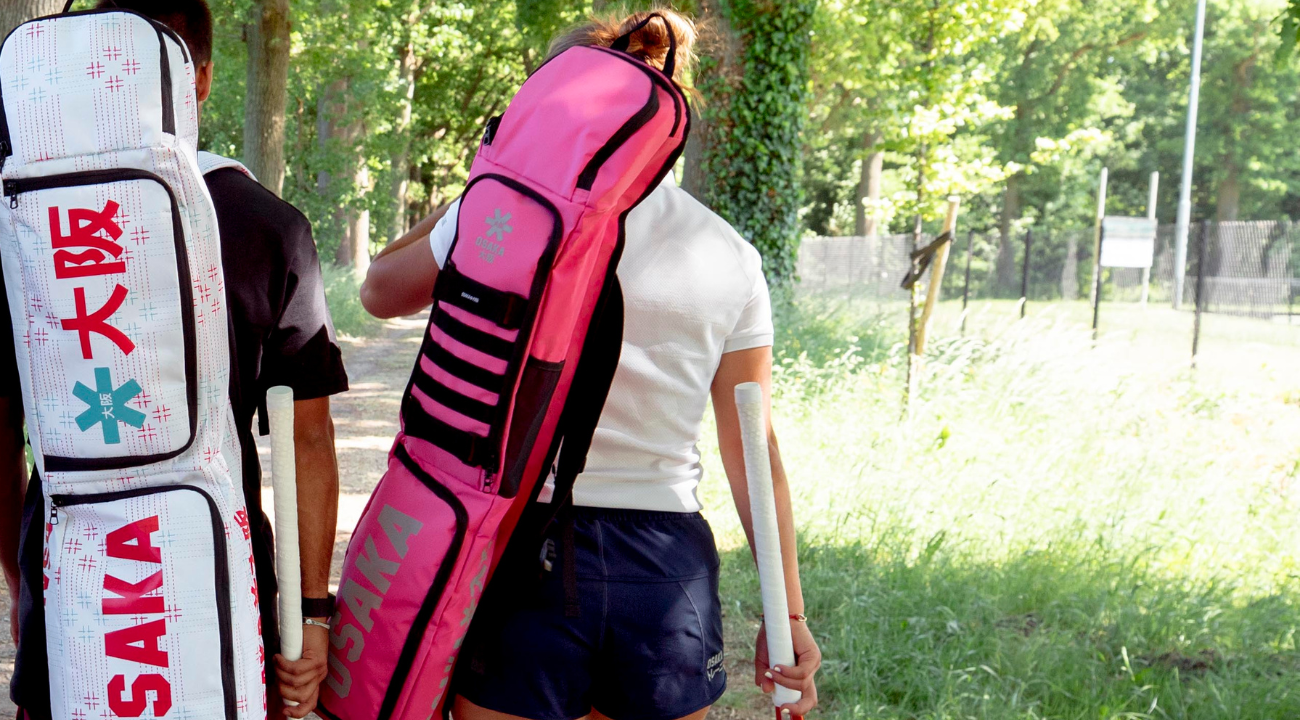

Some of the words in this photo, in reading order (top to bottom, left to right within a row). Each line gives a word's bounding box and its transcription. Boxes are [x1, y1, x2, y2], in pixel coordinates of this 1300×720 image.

[48, 199, 136, 360] 大阪
[475, 236, 505, 257] OSAKA
[99, 392, 115, 419] 大阪
[101, 514, 173, 718] SAKA
[326, 503, 424, 699] OSAKA
